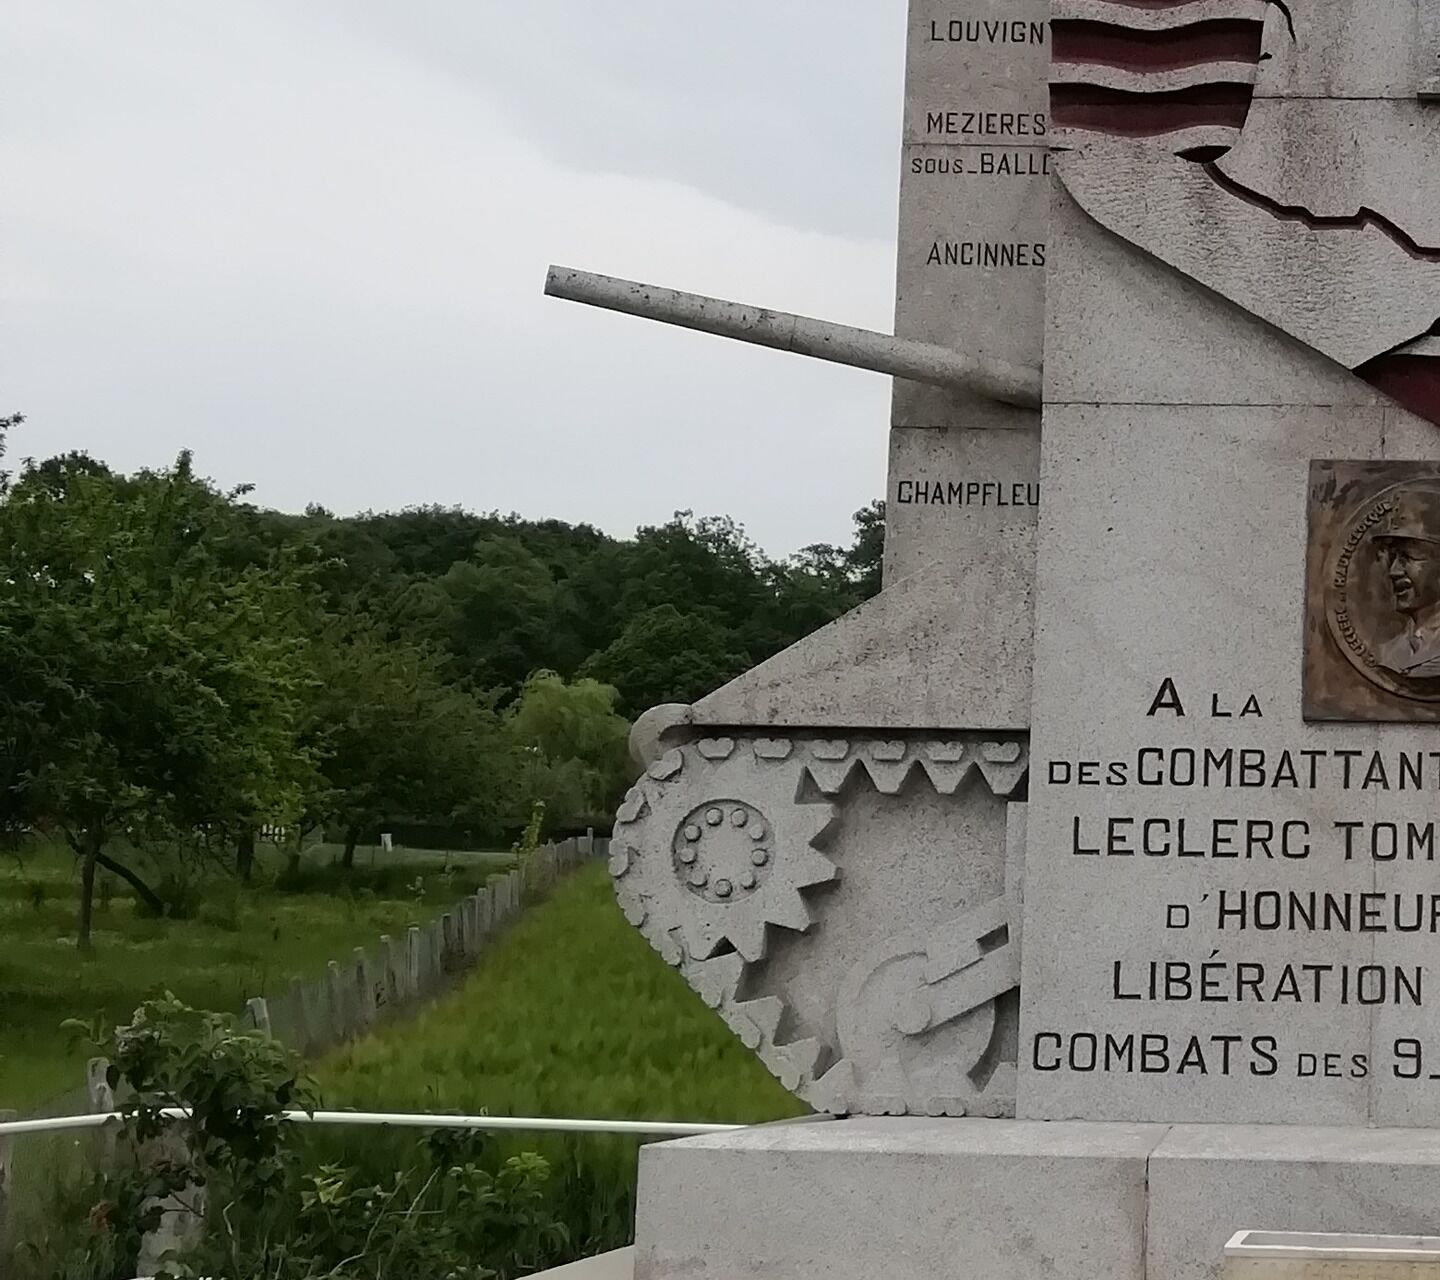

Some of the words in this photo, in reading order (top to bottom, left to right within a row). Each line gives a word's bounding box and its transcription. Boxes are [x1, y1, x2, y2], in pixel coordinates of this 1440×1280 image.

[931, 20, 1052, 44] LOUVIGN
[926, 111, 1047, 136] MEZIERES
[927, 242, 1045, 267] ANCINNES
[898, 481, 1040, 506] CHAMPFLEU
[1146, 677, 1186, 718] A
[1210, 693, 1263, 718] LA
[1048, 760, 1128, 786] DES
[1073, 816, 1310, 860] LECLERC
[1113, 949, 1423, 1006] LIBÉRATION
[1033, 1032, 1279, 1077] COMBATS
[1297, 1053, 1369, 1078] DES
